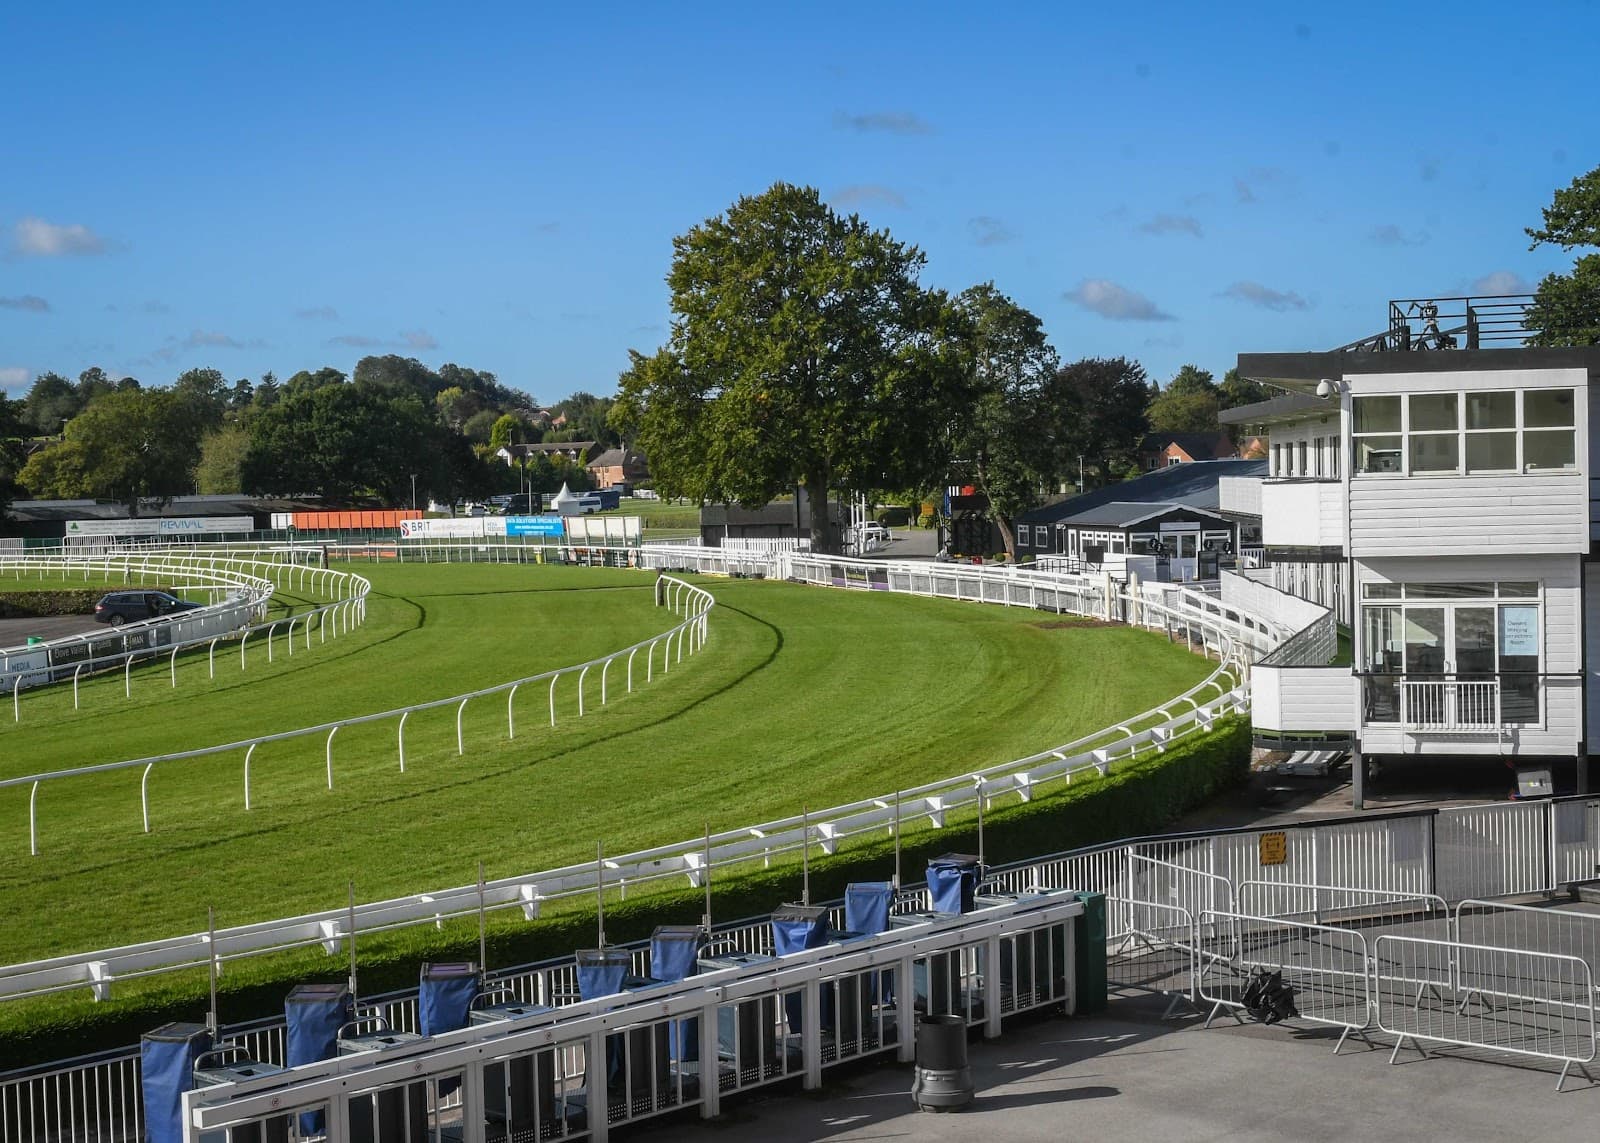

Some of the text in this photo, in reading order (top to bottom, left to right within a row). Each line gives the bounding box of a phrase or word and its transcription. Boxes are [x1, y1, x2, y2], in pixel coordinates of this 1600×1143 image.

[160, 519, 204, 529] REVIVAL
[411, 521, 430, 532] BRIT
[11, 661, 30, 672] MEDIA
